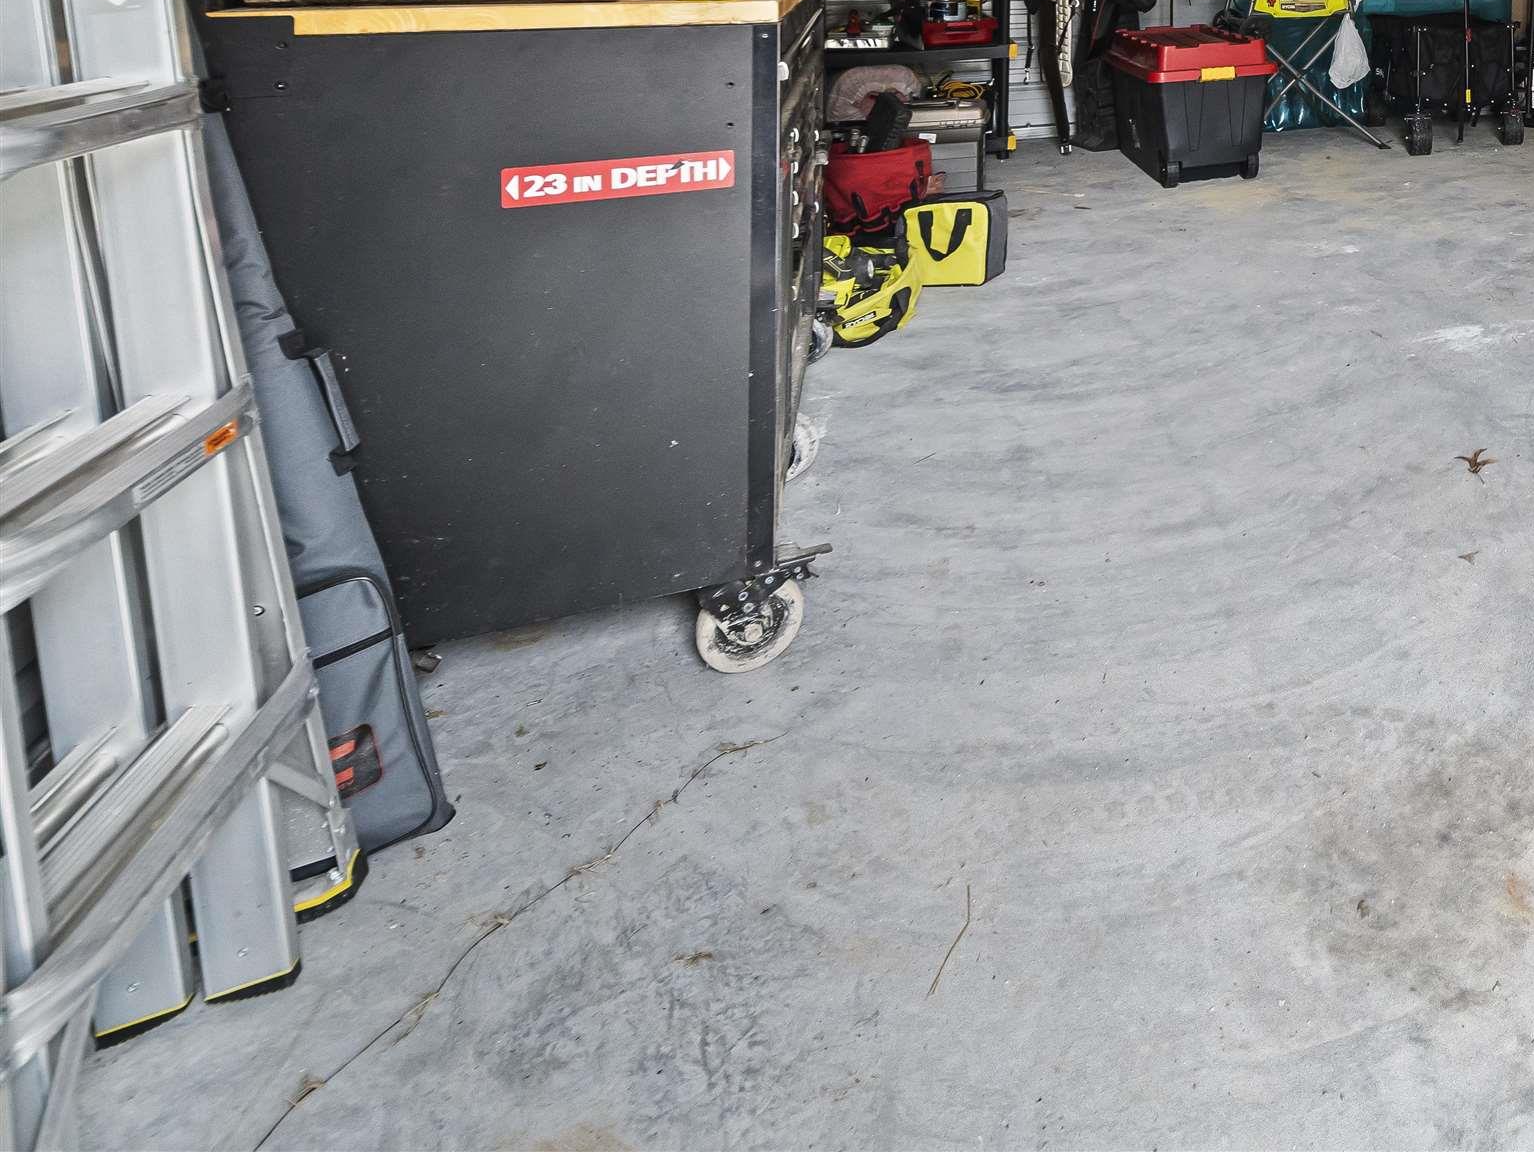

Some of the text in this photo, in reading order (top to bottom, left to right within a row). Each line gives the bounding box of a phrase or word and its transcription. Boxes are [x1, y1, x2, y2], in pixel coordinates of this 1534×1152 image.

[522, 160, 718, 198] 23 IN DEPTH
